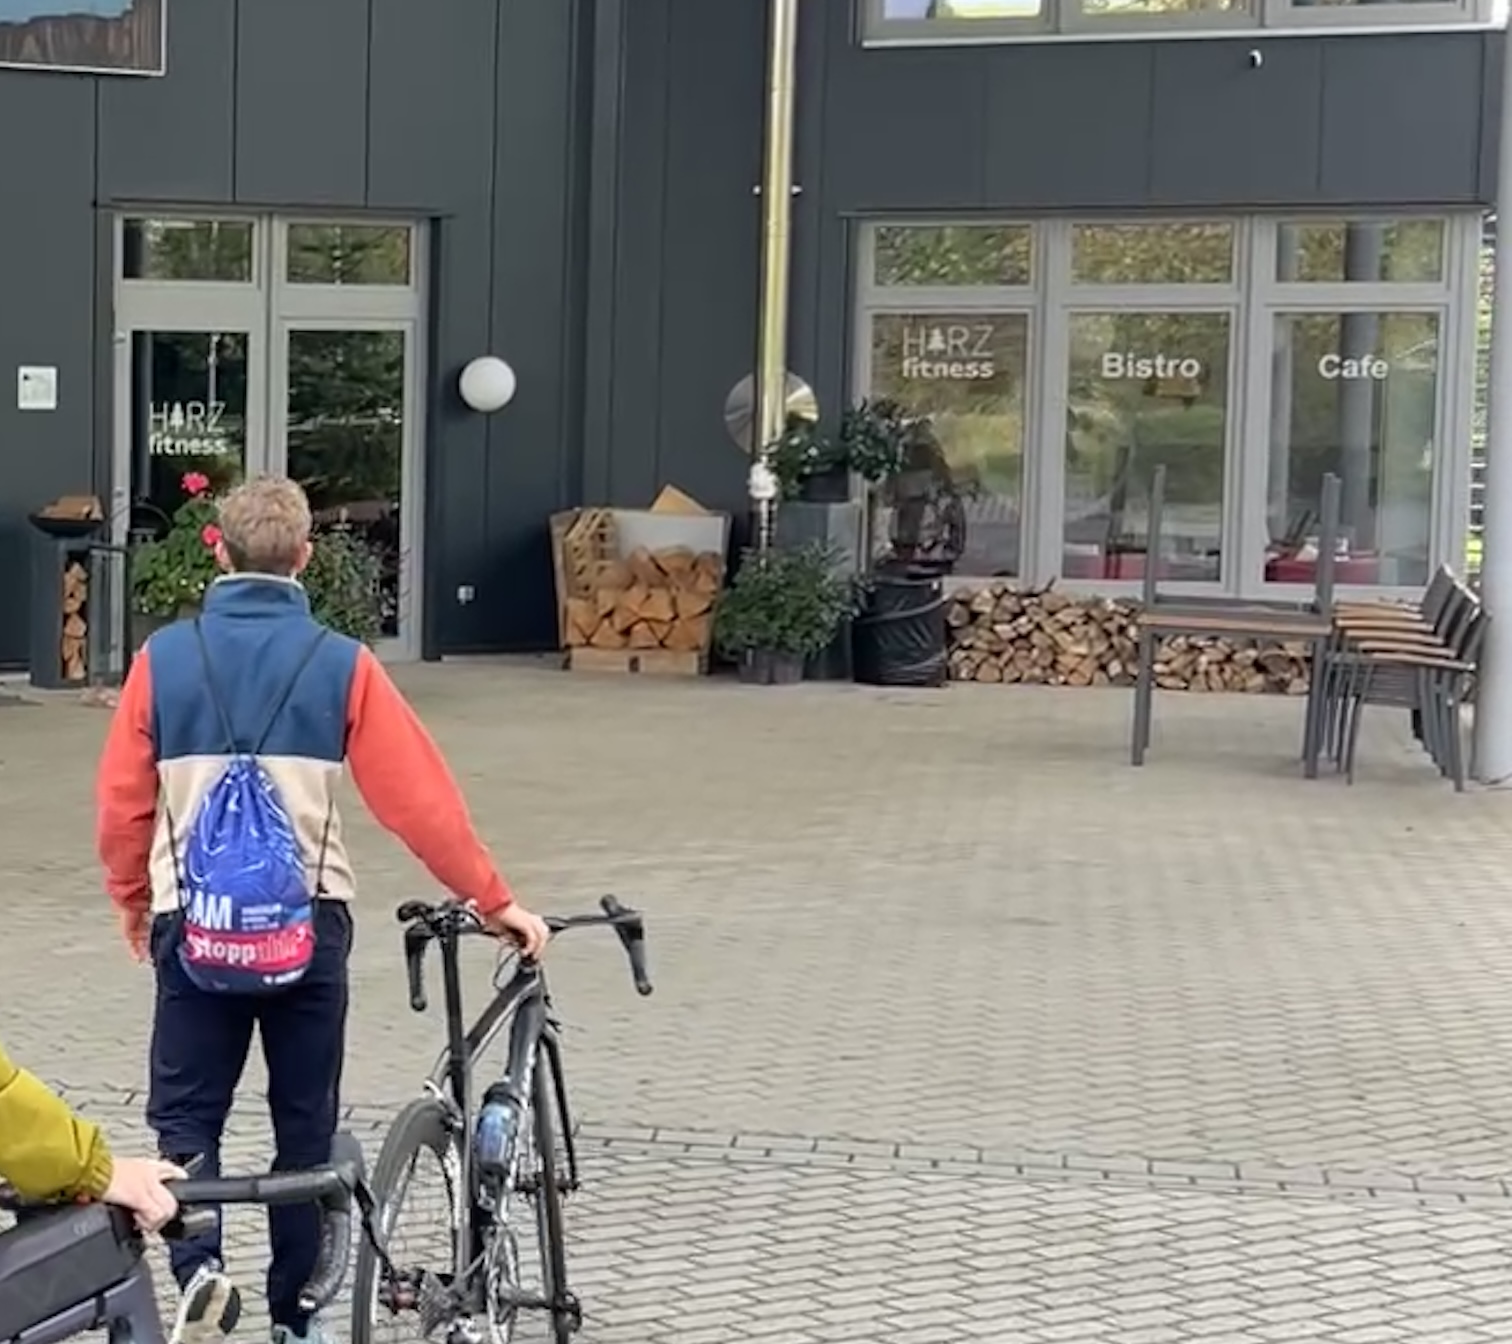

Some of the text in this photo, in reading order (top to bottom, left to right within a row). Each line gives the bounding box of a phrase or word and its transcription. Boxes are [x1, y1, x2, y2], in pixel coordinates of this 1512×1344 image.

[903, 357, 995, 379] fitness
[1101, 352, 1201, 378] Bistro
[1317, 353, 1389, 380] Cafe
[149, 432, 228, 456] fitness
